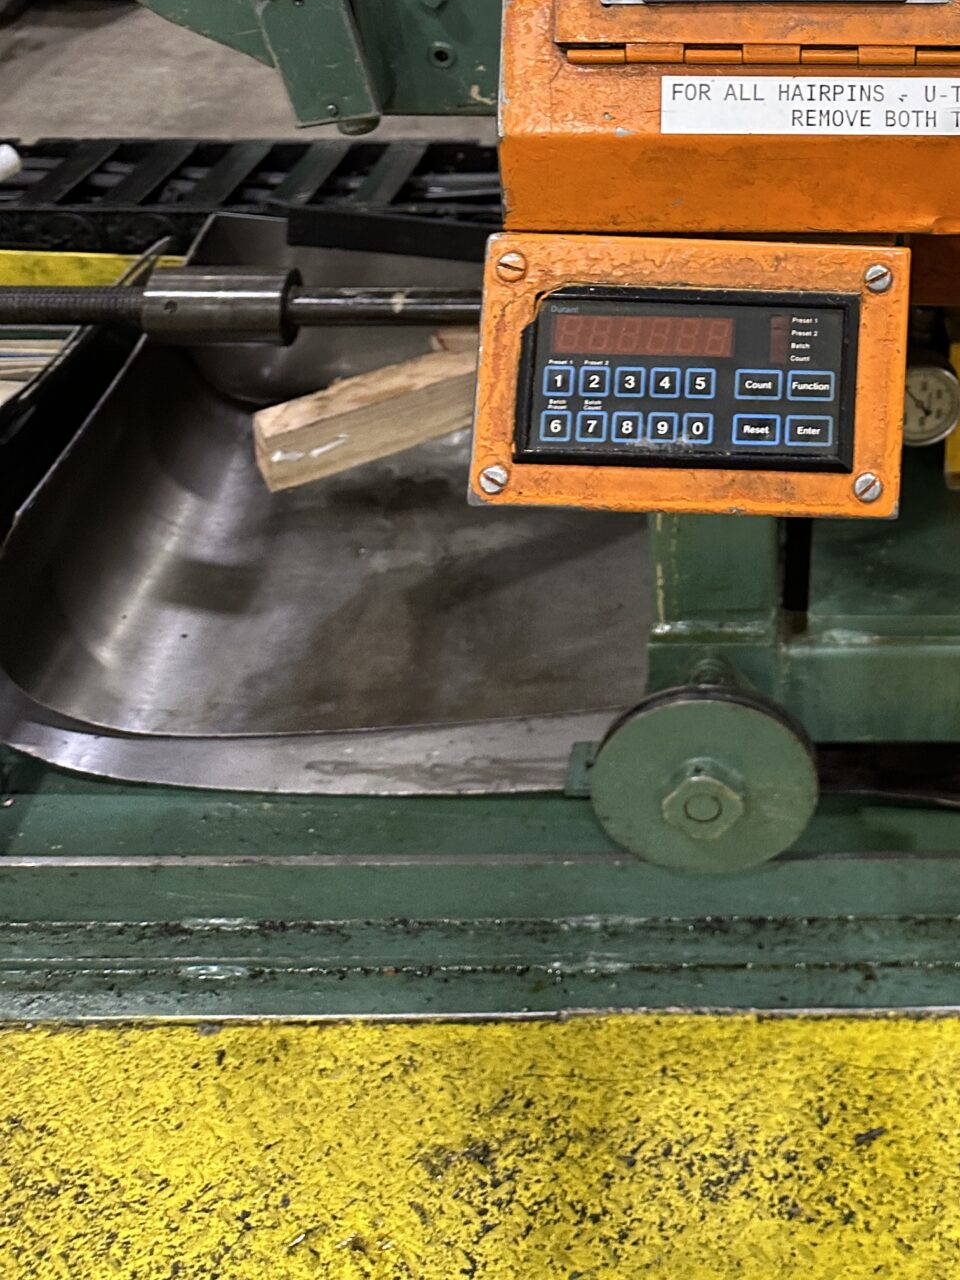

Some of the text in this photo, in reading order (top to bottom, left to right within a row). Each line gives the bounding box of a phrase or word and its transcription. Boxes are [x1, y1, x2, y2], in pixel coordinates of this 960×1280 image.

[671, 83, 711, 101] FOR
[724, 84, 765, 101] ALL
[778, 84, 885, 102] HAIRPINS
[791, 109, 871, 127] REMOVE
[884, 110, 937, 128] BOTH
[554, 374, 562, 387] 1
[589, 375, 600, 388] 2
[624, 375, 635, 389] 3
[659, 376, 670, 389] 4
[695, 377, 706, 390] 5
[744, 380, 772, 389] Count
[792, 381, 830, 390] Function
[550, 419, 562, 432] 6
[587, 420, 597, 433] 7
[621, 421, 633, 434] 8
[657, 421, 668, 435] 9
[692, 422, 704, 435] 0
[743, 425, 769, 434] Reset
[796, 426, 821, 435] Enter
